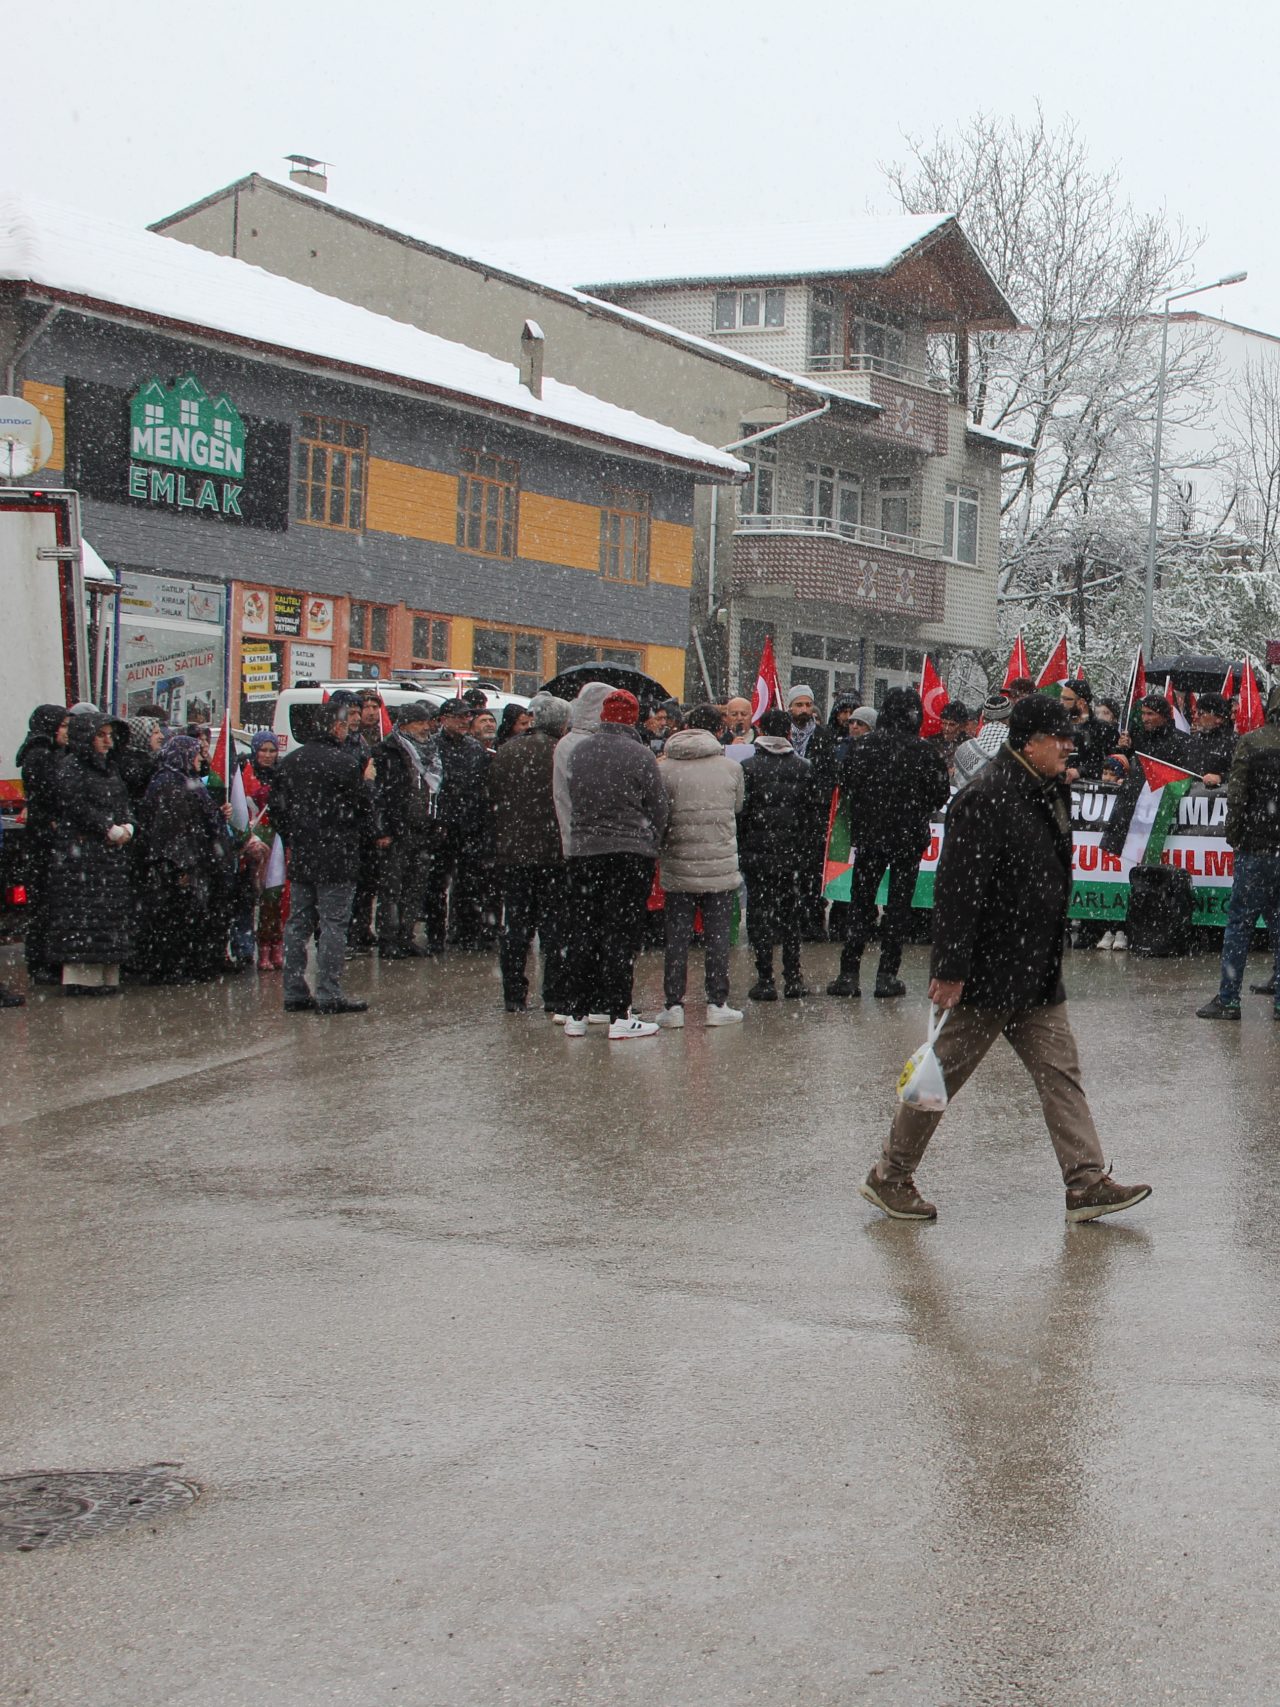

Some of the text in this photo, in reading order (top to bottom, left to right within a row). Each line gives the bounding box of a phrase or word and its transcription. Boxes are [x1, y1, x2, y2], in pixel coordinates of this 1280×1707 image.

[132, 426, 242, 473] MENGEN
[129, 465, 243, 516] EMLAK
[127, 663, 165, 681] ALINIR
